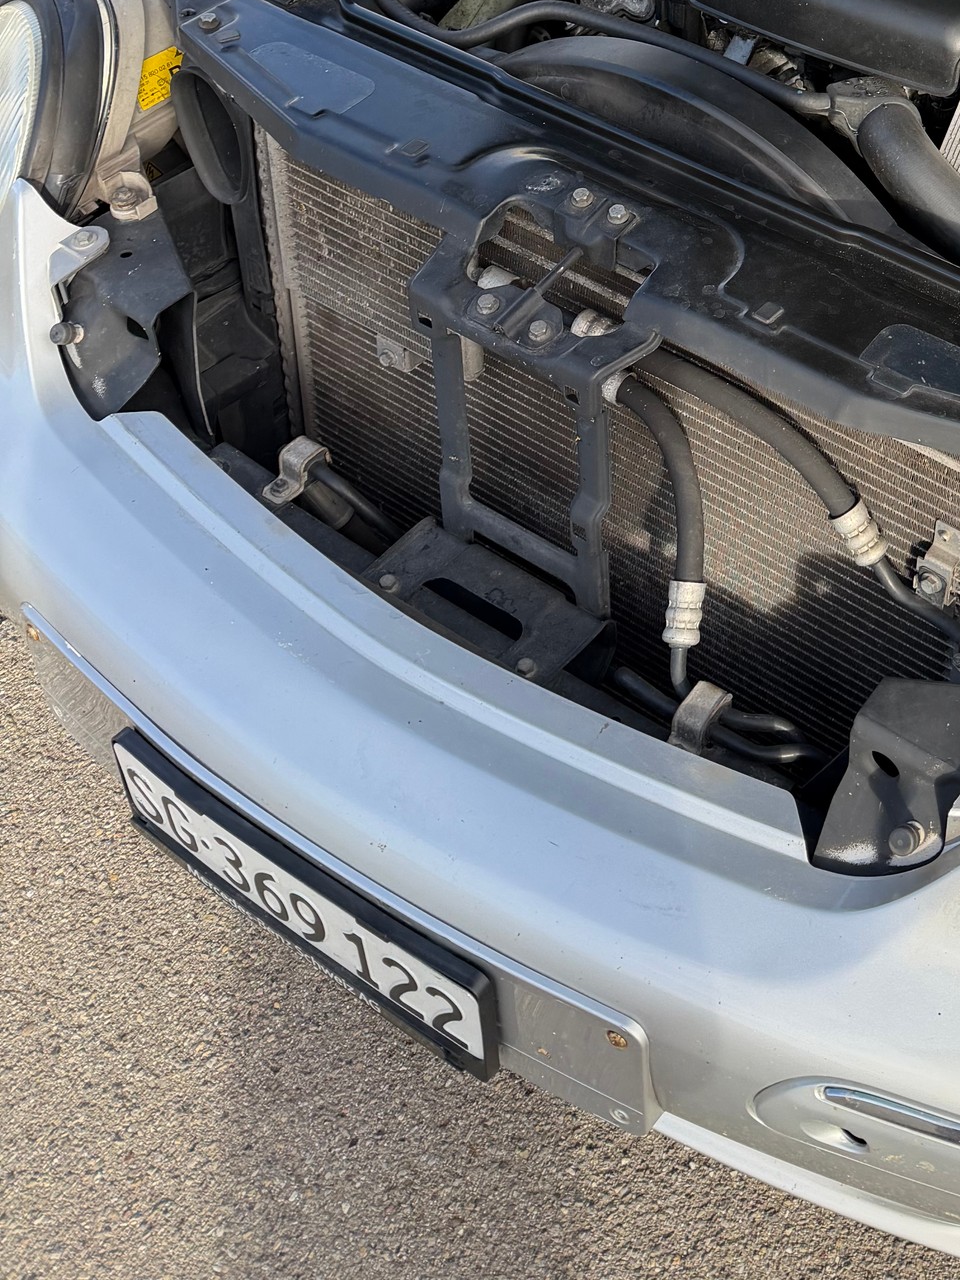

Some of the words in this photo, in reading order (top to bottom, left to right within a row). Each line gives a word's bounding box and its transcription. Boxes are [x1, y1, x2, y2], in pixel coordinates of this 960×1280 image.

[213, 836, 326, 943] 369
[342, 931, 469, 1051] 122
[358, 990, 382, 1014] AG
